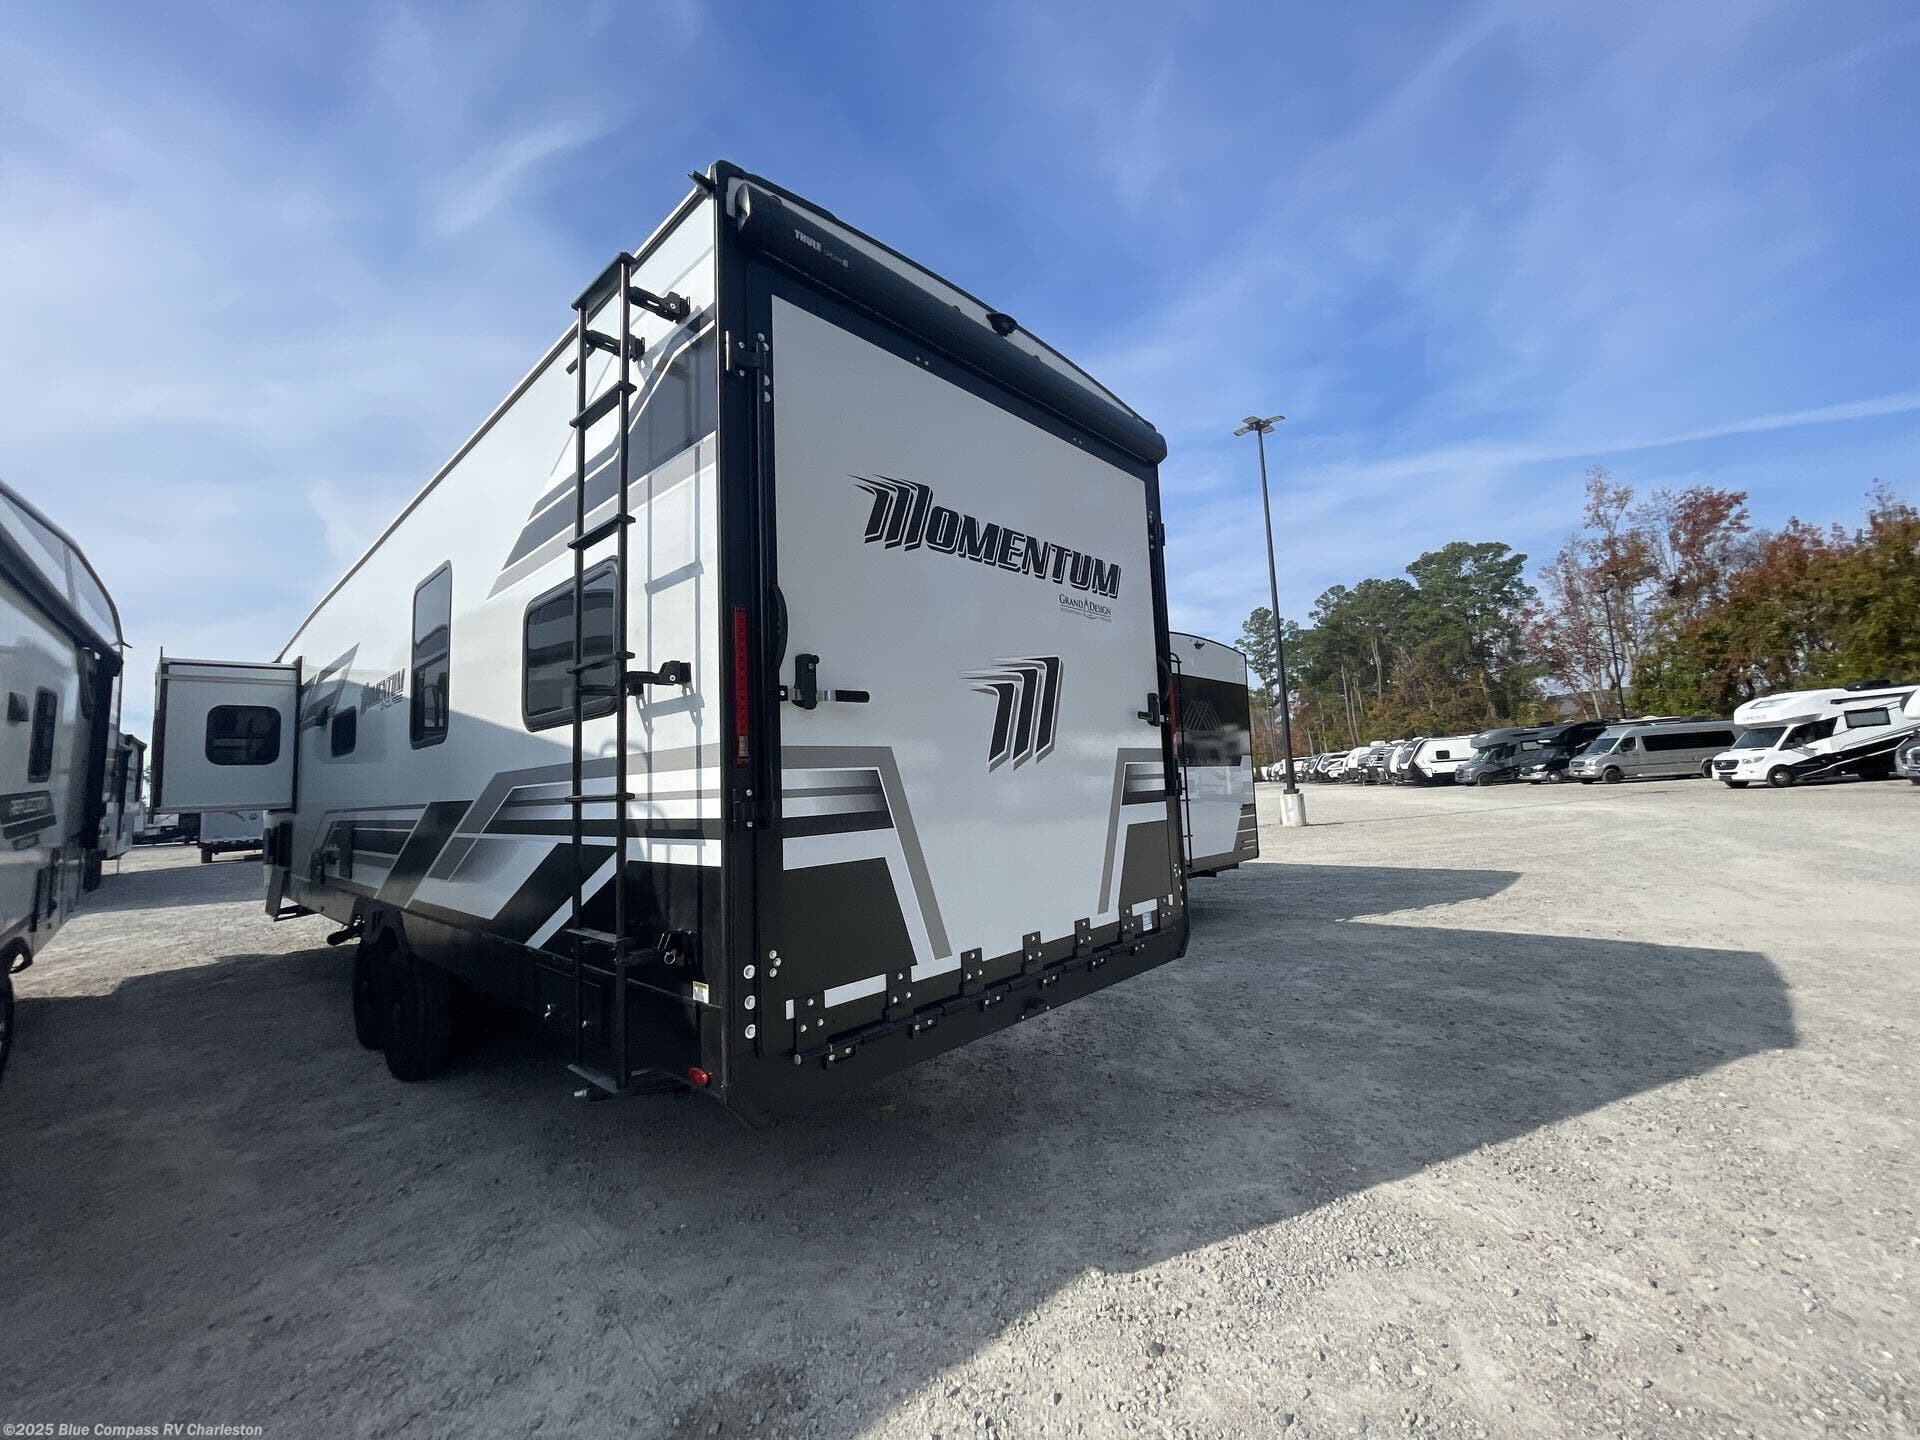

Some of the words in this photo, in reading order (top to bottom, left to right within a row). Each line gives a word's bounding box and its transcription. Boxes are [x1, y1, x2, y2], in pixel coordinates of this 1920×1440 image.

[794, 228, 822, 253] THULE
[848, 473, 1121, 599] MOMENTUM
[1059, 593, 1084, 609] GRAND
[1089, 601, 1111, 616] DESIGN
